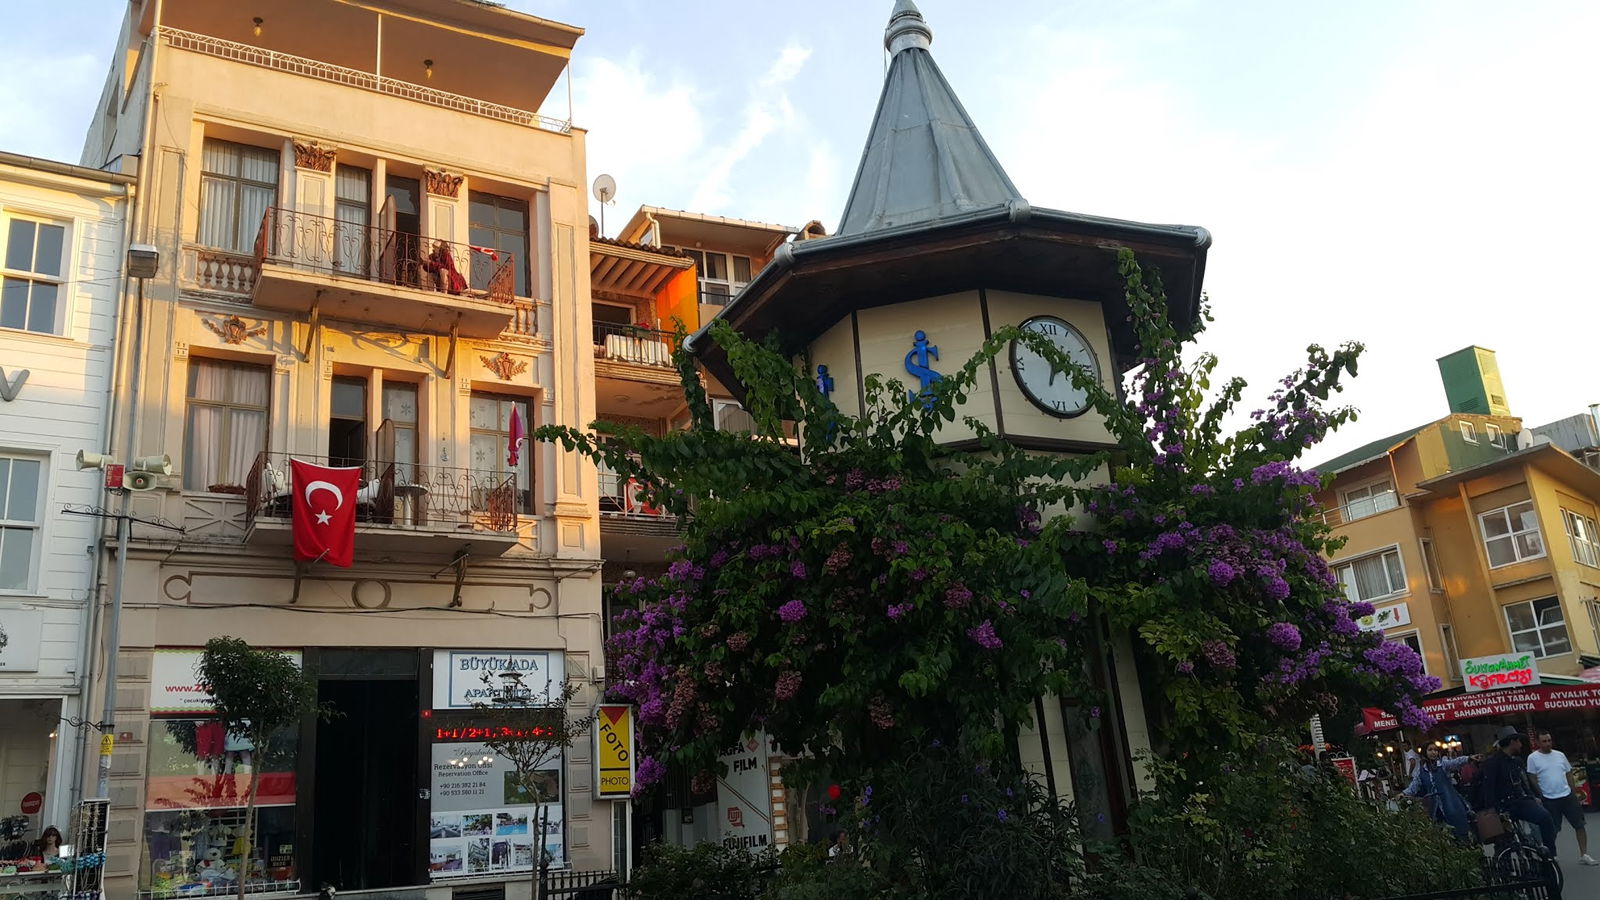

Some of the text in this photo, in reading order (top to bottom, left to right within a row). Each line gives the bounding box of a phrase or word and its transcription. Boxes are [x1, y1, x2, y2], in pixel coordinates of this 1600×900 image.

[1039, 323, 1057, 335] XII
[1463, 696, 1506, 708] KAHVALTI
[1507, 692, 1540, 702] TABAĞI
[1550, 690, 1590, 699] AYVALIK
[1454, 706, 1494, 718] SAHANDA
[1494, 702, 1536, 713] YUMURTA
[1544, 699, 1587, 709] SUCUKLU
[600, 723, 629, 762] FOTO
[733, 757, 757, 773] FILM
[601, 776, 629, 786] PHOTO
[722, 834, 768, 850] FUJIFILM
